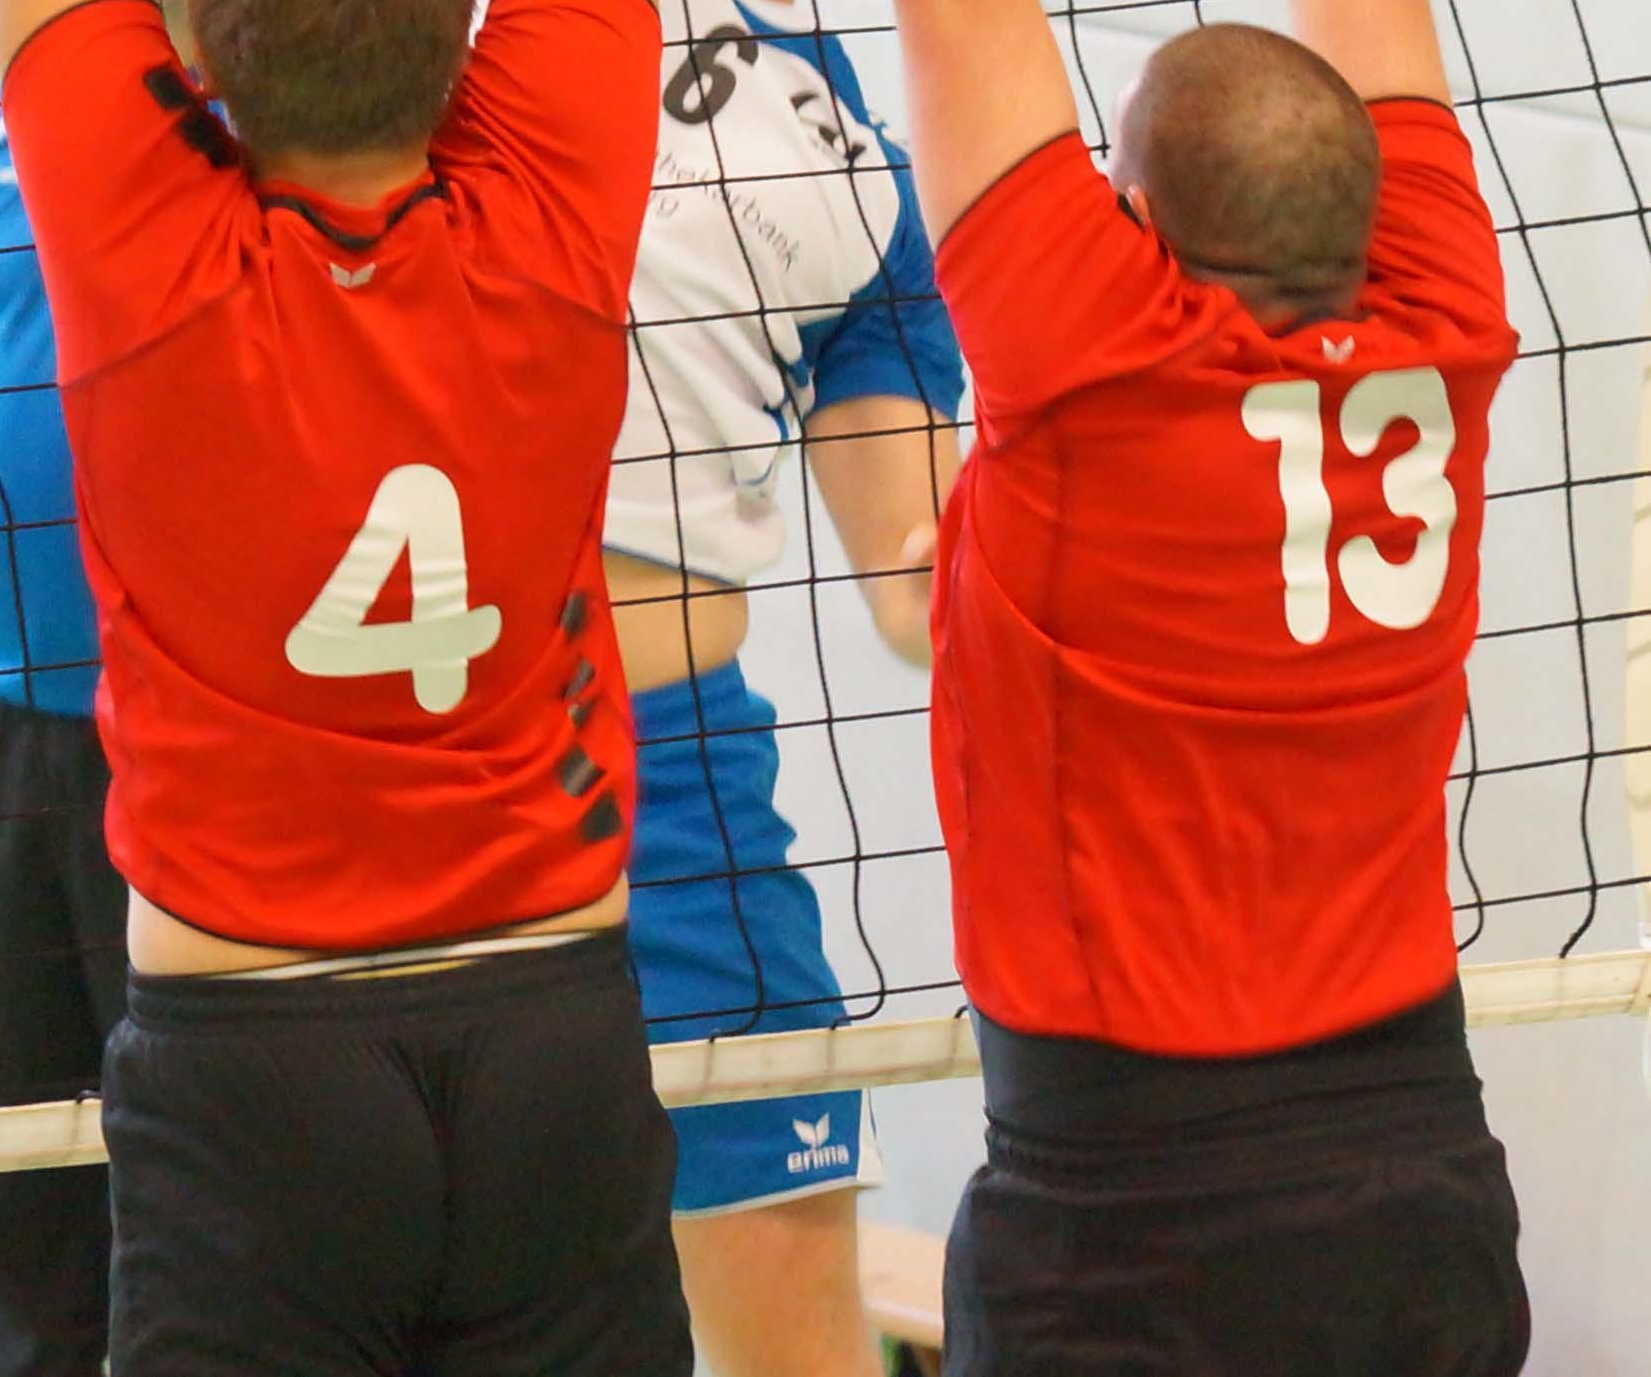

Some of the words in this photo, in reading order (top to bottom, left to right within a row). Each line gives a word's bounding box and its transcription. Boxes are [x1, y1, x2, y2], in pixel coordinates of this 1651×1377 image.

[662, 24, 758, 124] 6
[285, 463, 502, 714] 4
[1241, 366, 1457, 645] 13
[788, 1144, 849, 1173] erima
